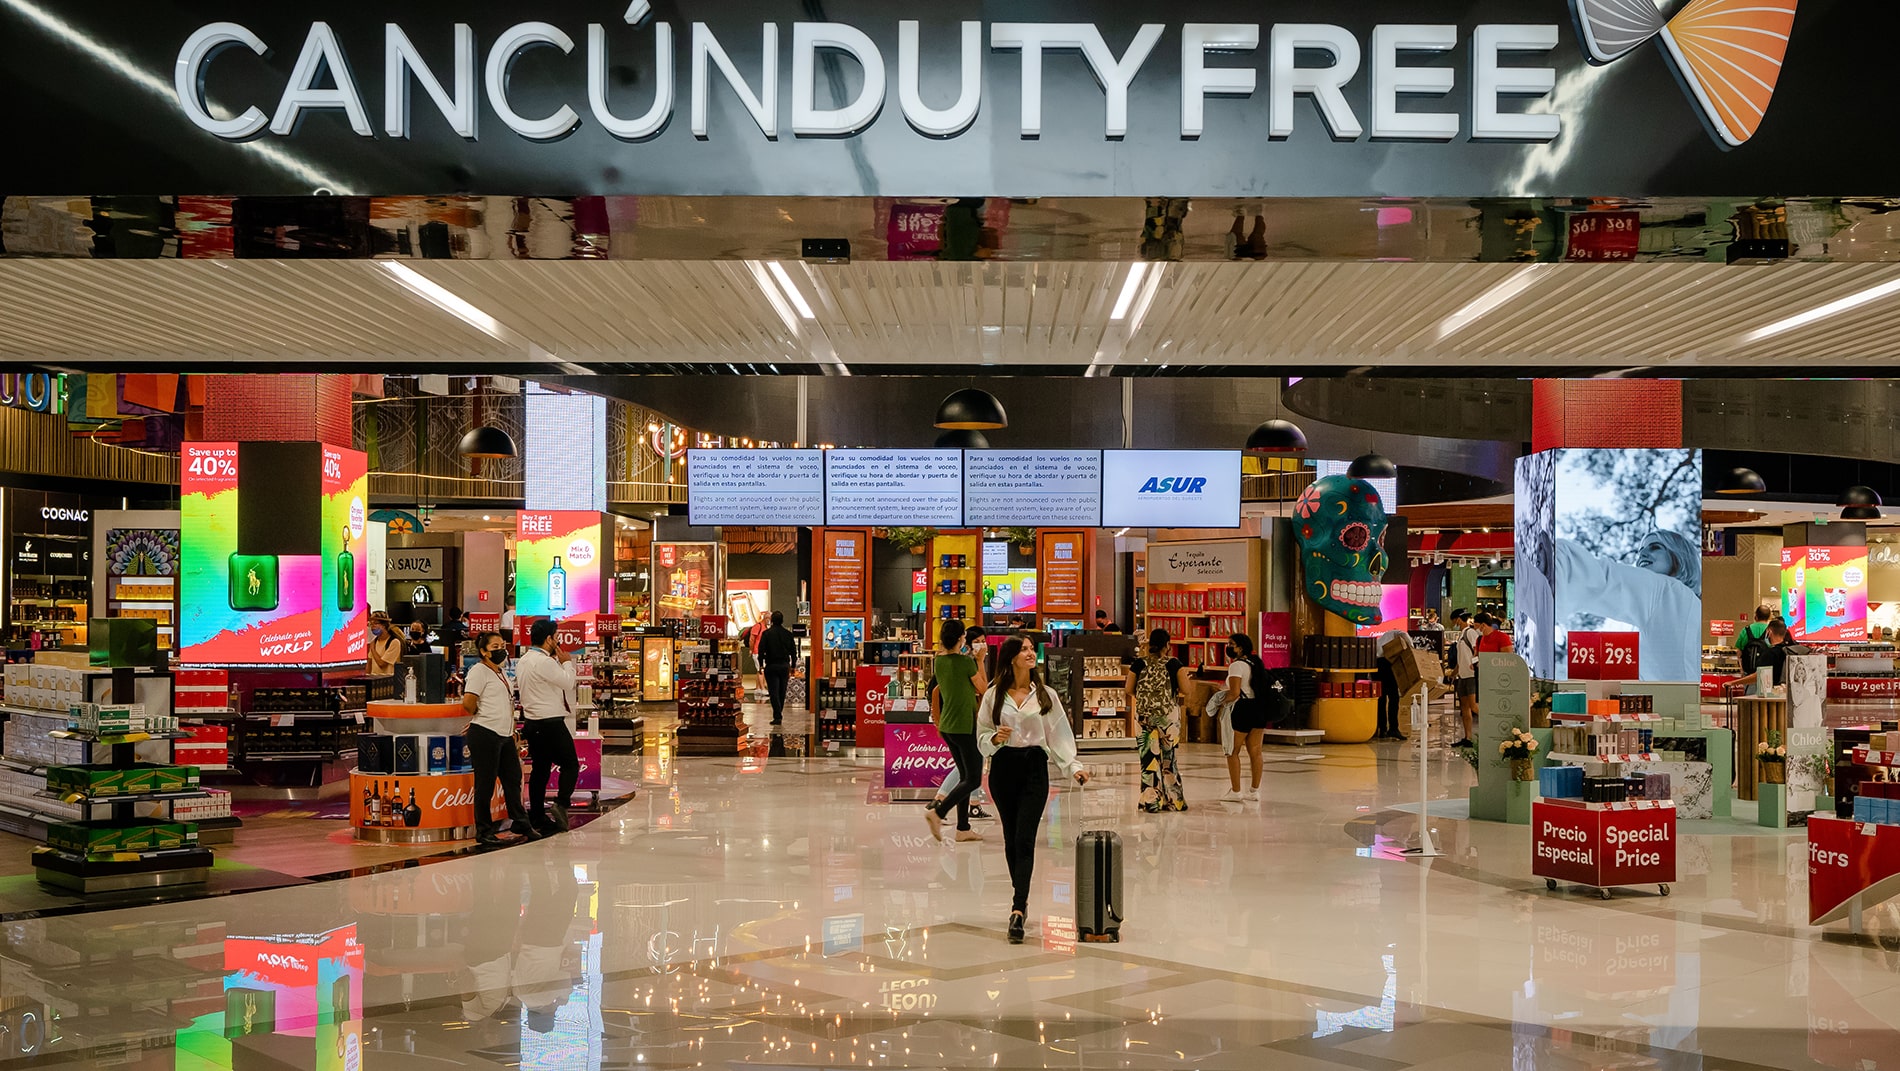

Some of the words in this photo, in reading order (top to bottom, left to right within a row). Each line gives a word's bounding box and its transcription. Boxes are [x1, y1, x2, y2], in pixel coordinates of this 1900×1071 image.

[189, 448, 211, 456] Save
[212, 450, 225, 459] up
[226, 448, 237, 457] to
[188, 457, 236, 476] 40%
[324, 458, 341, 479] 40%
[831, 472, 858, 480] verifique
[928, 472, 948, 480] puerta
[876, 480, 905, 488] pantallas.
[1138, 477, 1207, 493] ASUR
[831, 496, 851, 504] Flights
[940, 496, 958, 504] public
[42, 507, 88, 522] COGNAC
[877, 504, 900, 512] system,
[901, 504, 916, 512] keep
[831, 513, 844, 521] gate
[873, 513, 903, 521] departure
[522, 521, 552, 531] FREE
[1186, 551, 1205, 559] Tequila
[1809, 553, 1830, 561] 30%
[398, 558, 431, 573] SAUZA
[1168, 552, 1222, 573] Esperanto
[470, 623, 493, 631] FREE
[703, 625, 723, 635] 20%
[260, 632, 293, 644] Celebrate
[294, 630, 313, 640] your
[1840, 630, 1864, 638] WORLD
[260, 640, 314, 656] WORLD
[1840, 681, 1860, 692] Buy
[1862, 682, 1868, 690] 2
[1870, 682, 1885, 692] get
[1887, 682, 1891, 690] 1
[1791, 732, 1822, 747] Chloé
[908, 743, 937, 752] Celebra
[892, 757, 958, 770] AHORRO
[432, 787, 474, 810] Celeb
[1543, 821, 1587, 842] Precio
[1606, 822, 1669, 849] Special
[1537, 841, 1594, 865] Especial
[1615, 849, 1660, 867] Price
